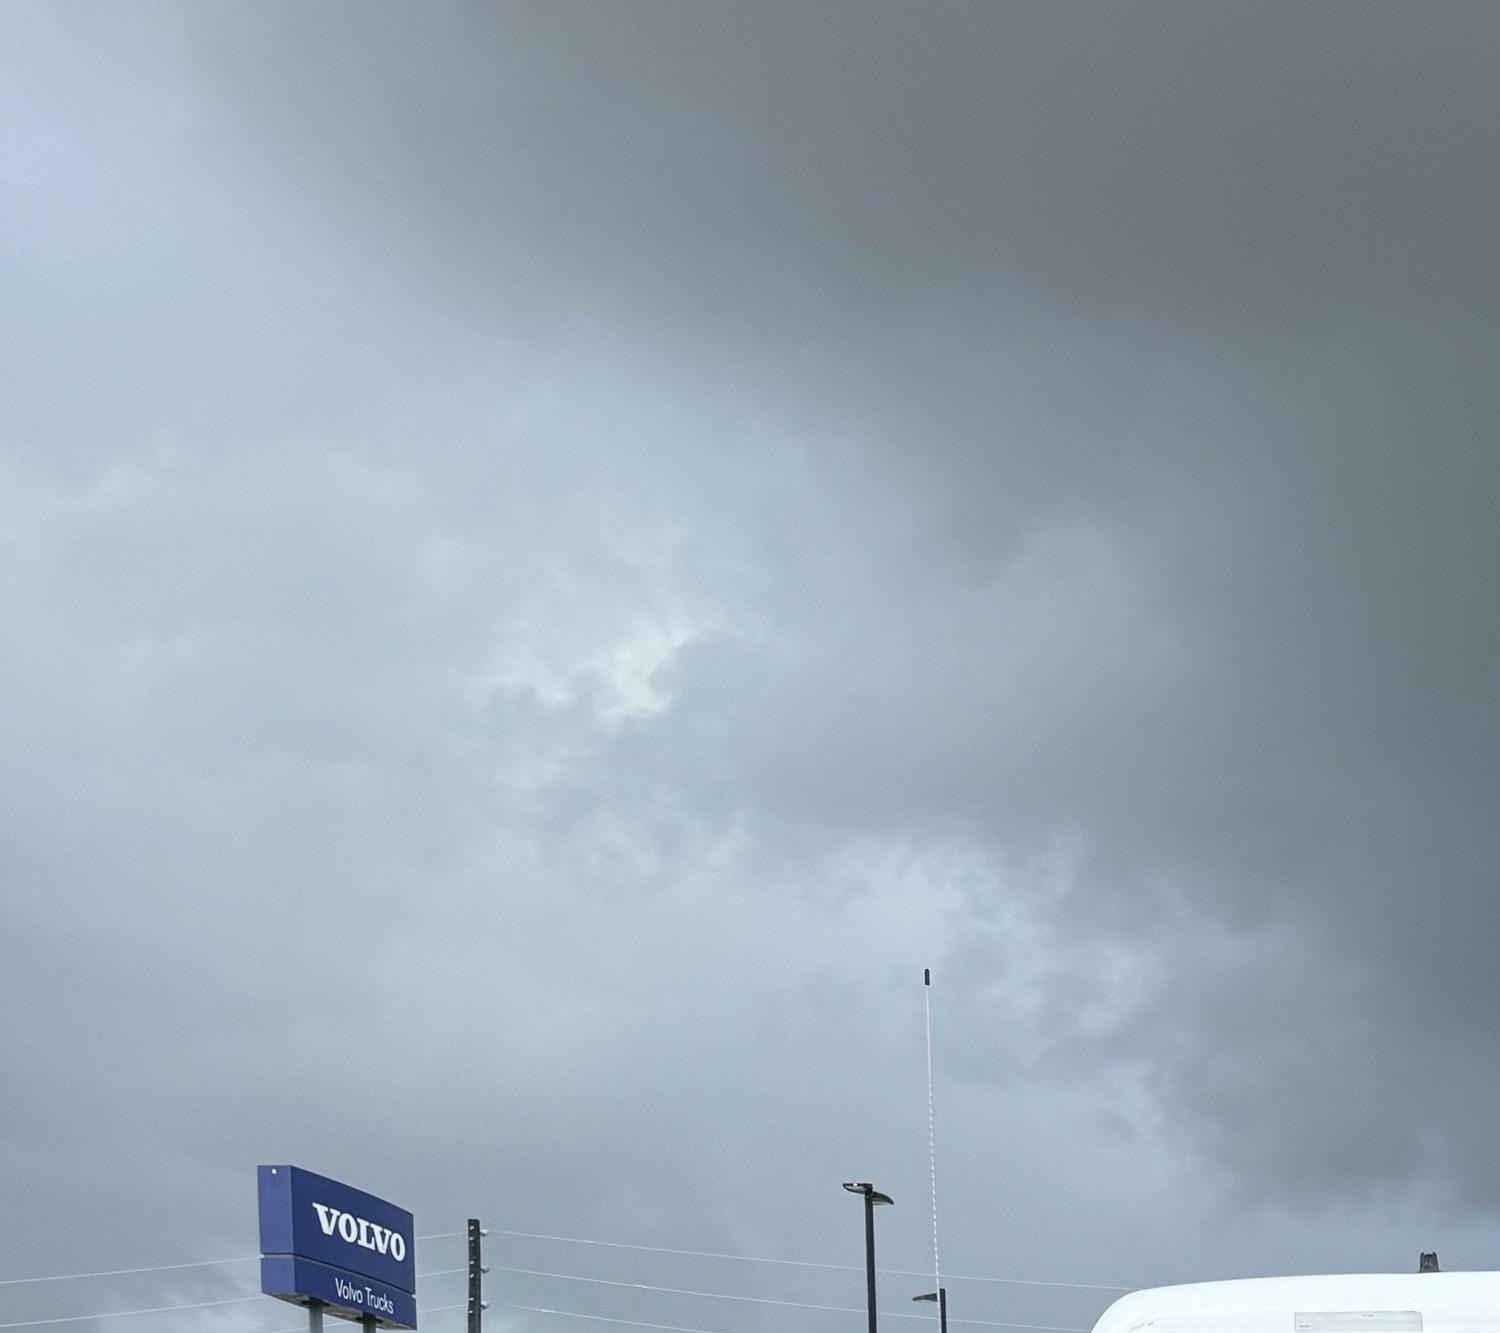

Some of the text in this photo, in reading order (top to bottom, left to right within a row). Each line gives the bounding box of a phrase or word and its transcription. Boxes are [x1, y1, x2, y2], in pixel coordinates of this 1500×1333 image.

[312, 1202, 406, 1262] VOLVO
[335, 1278, 394, 1314] Volvo Trucks
